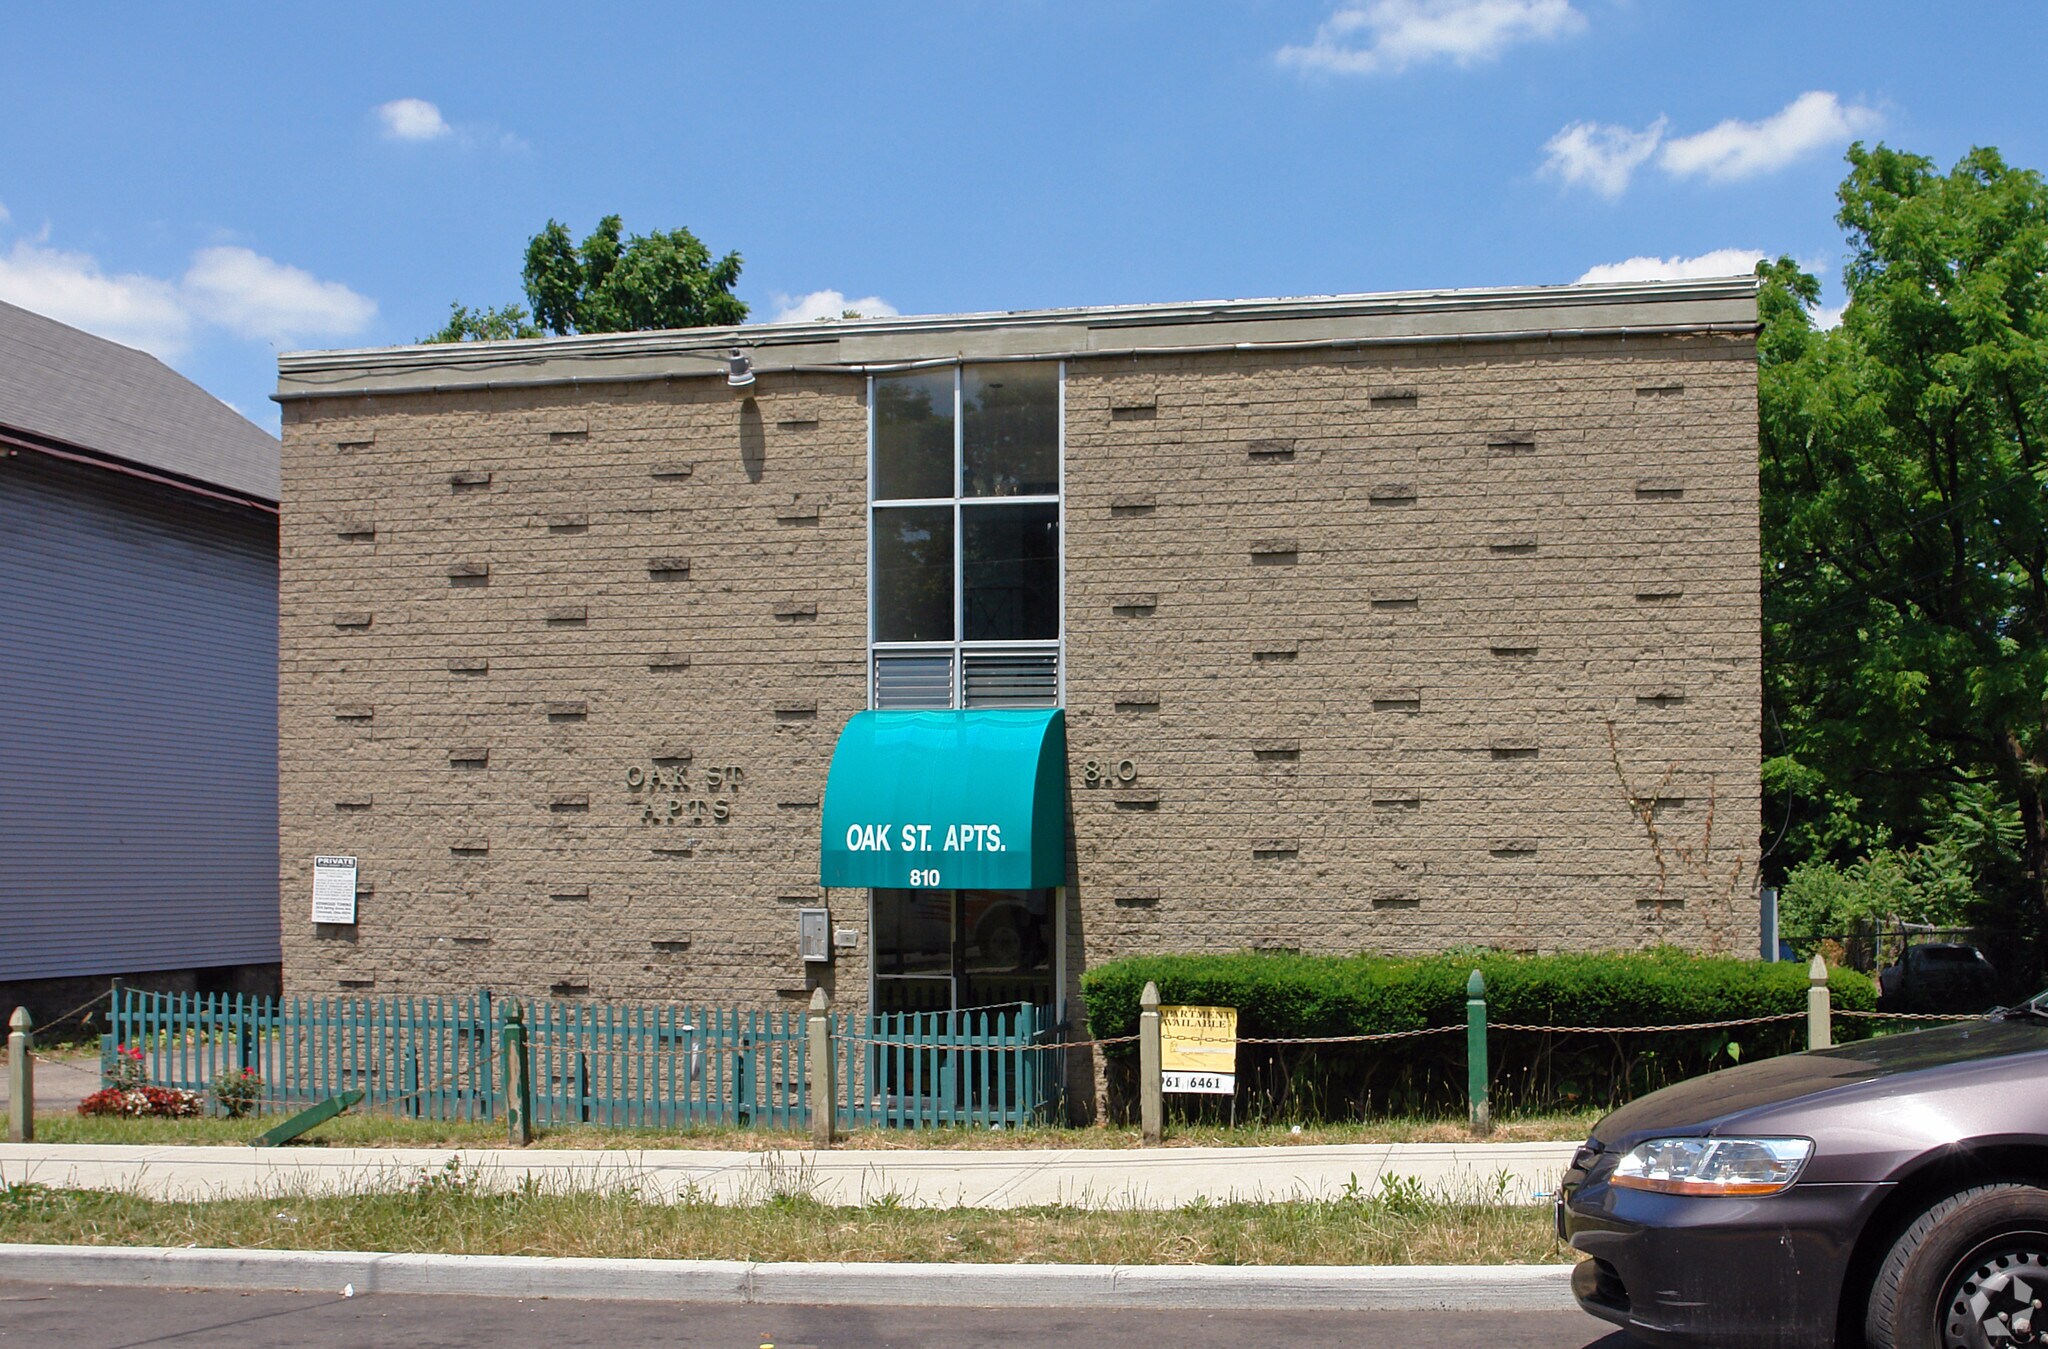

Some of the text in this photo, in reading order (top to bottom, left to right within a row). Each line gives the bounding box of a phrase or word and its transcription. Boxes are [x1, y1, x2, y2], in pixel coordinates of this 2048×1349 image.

[626, 765, 743, 787] OAK ST
[1084, 759, 1137, 781] 810
[641, 799, 729, 820] APTS
[846, 824, 1006, 852] OAK ST. APTS.
[910, 869, 940, 887] 810
[1162, 1019, 1227, 1028] AVAILABLE
[1161, 1077, 1220, 1089] 61 6461
